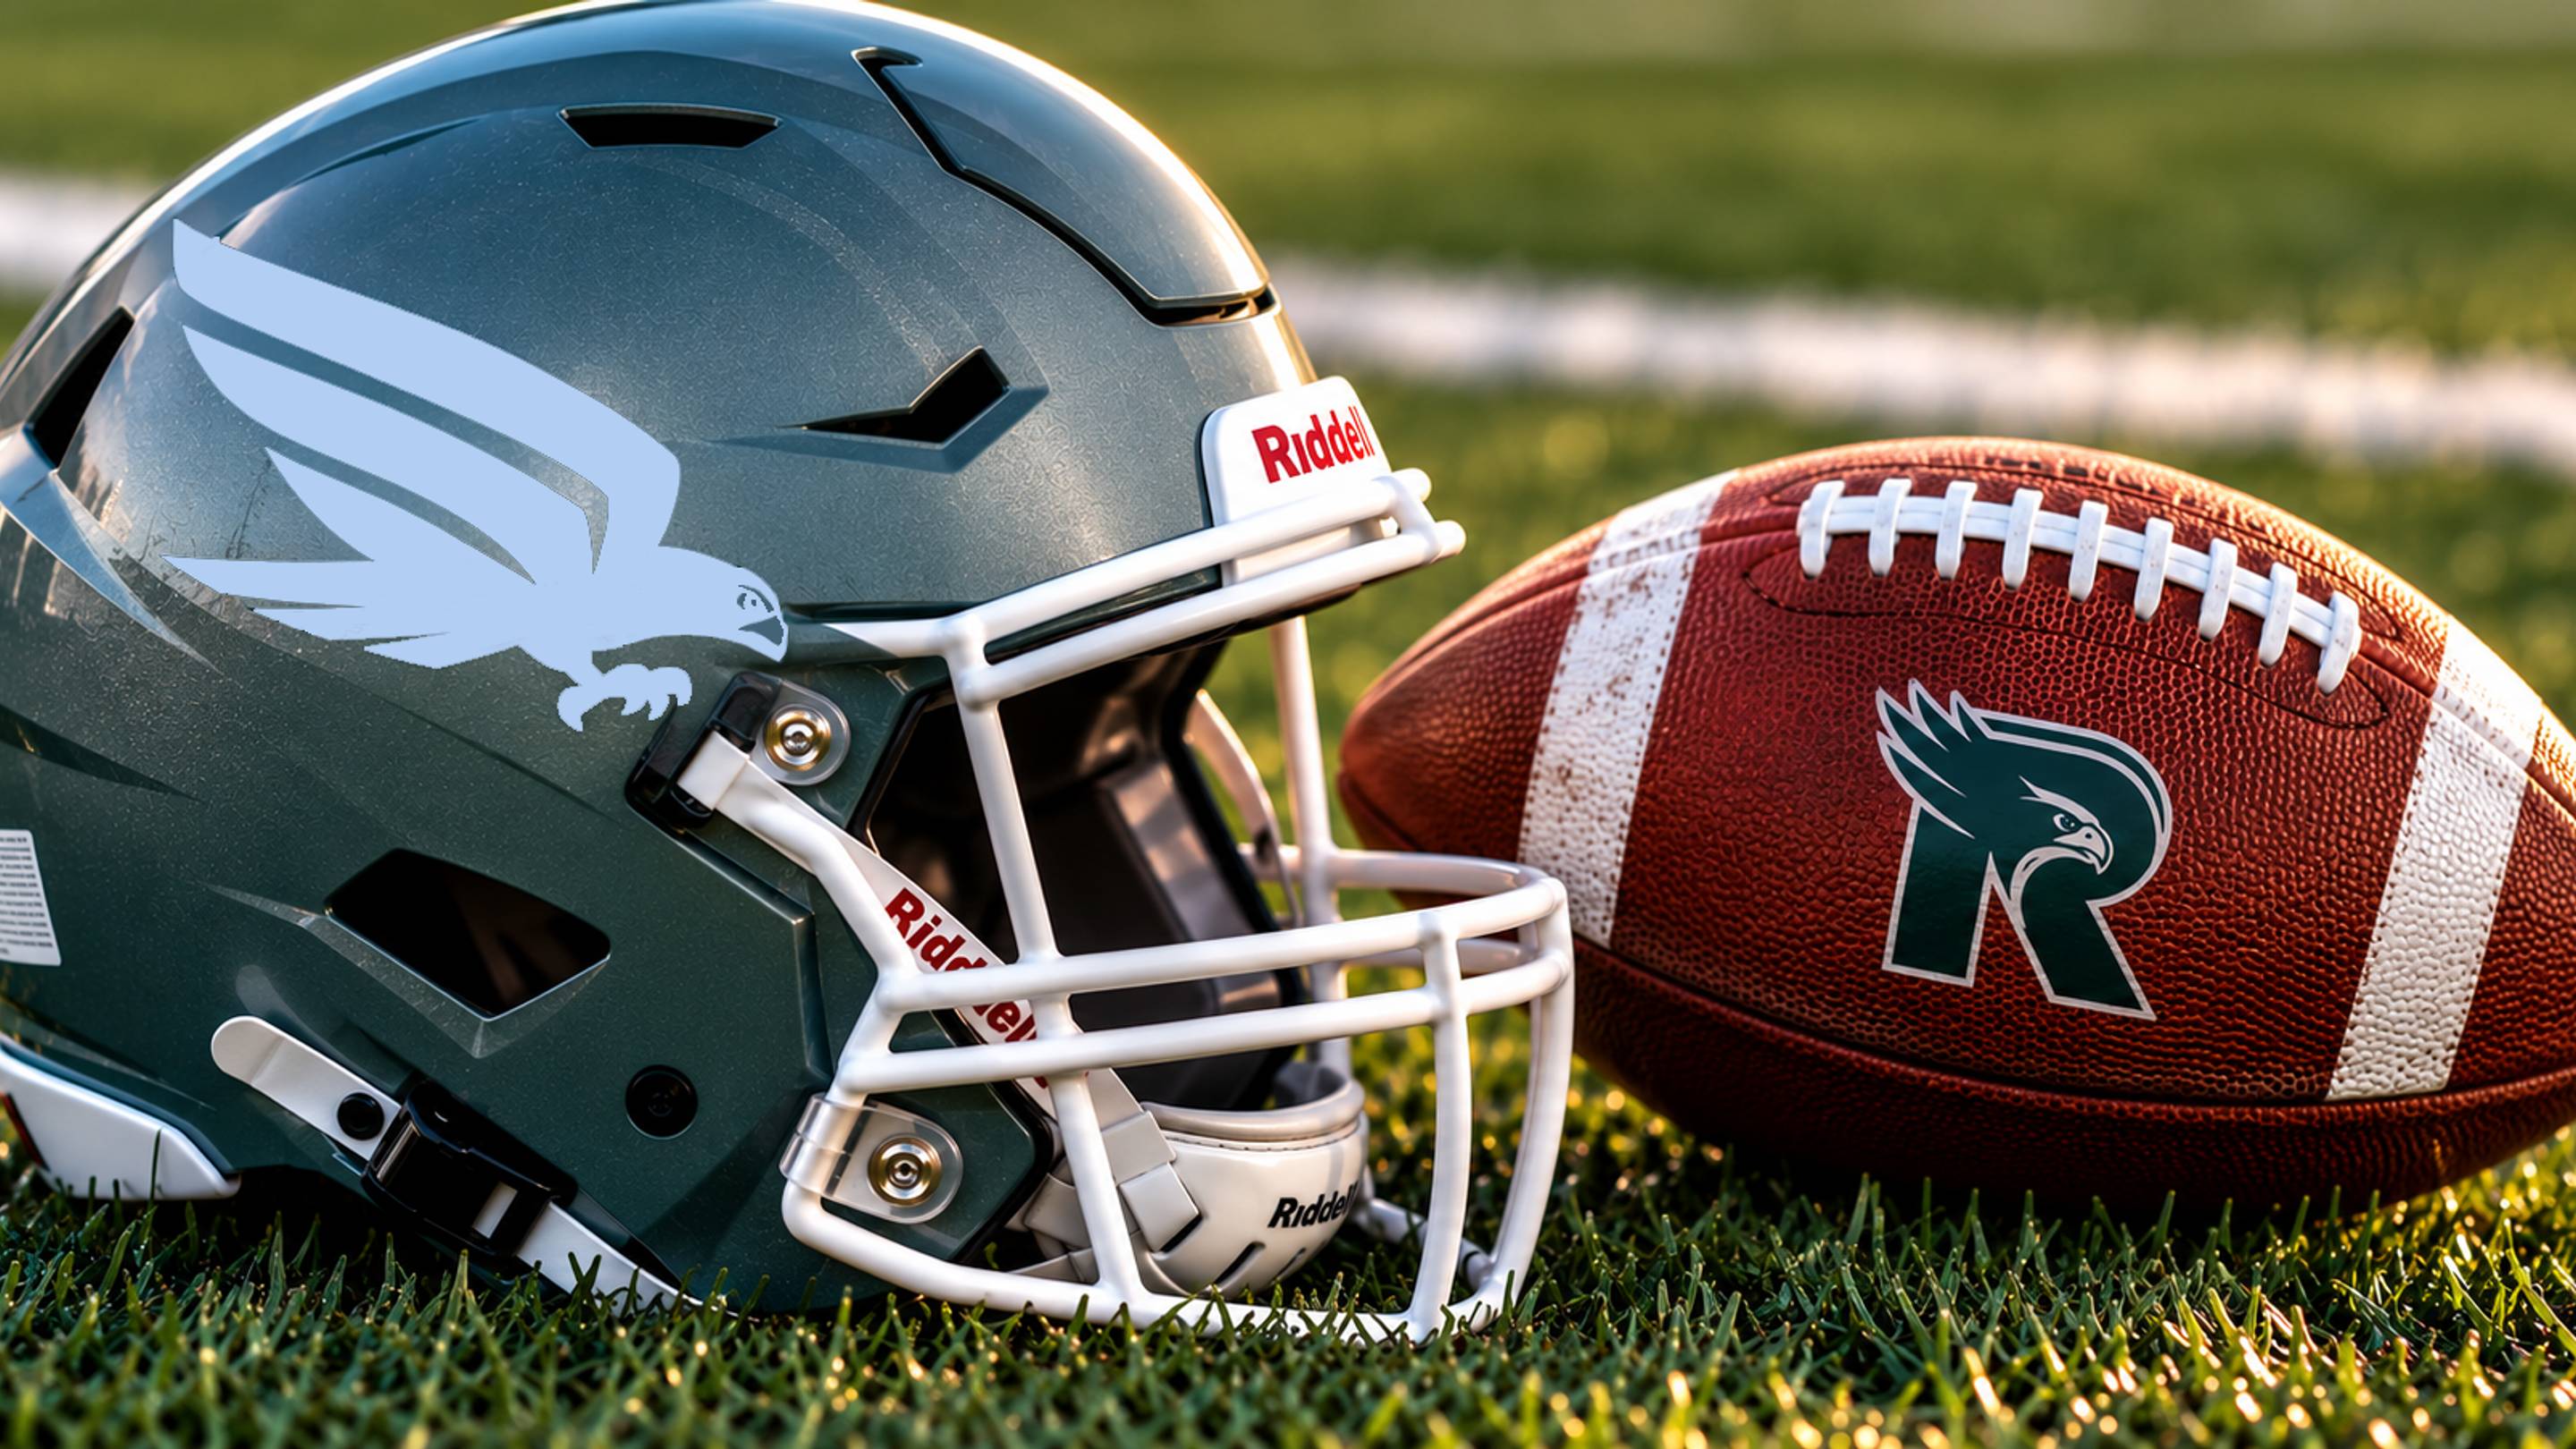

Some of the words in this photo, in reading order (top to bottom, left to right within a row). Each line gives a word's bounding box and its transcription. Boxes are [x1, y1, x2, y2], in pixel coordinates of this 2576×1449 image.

[1251, 406, 1375, 483] Riddell
[1876, 679, 2174, 1021] R
[886, 887, 1047, 1089] Ridel
[1267, 1181, 1359, 1228] Riddell
